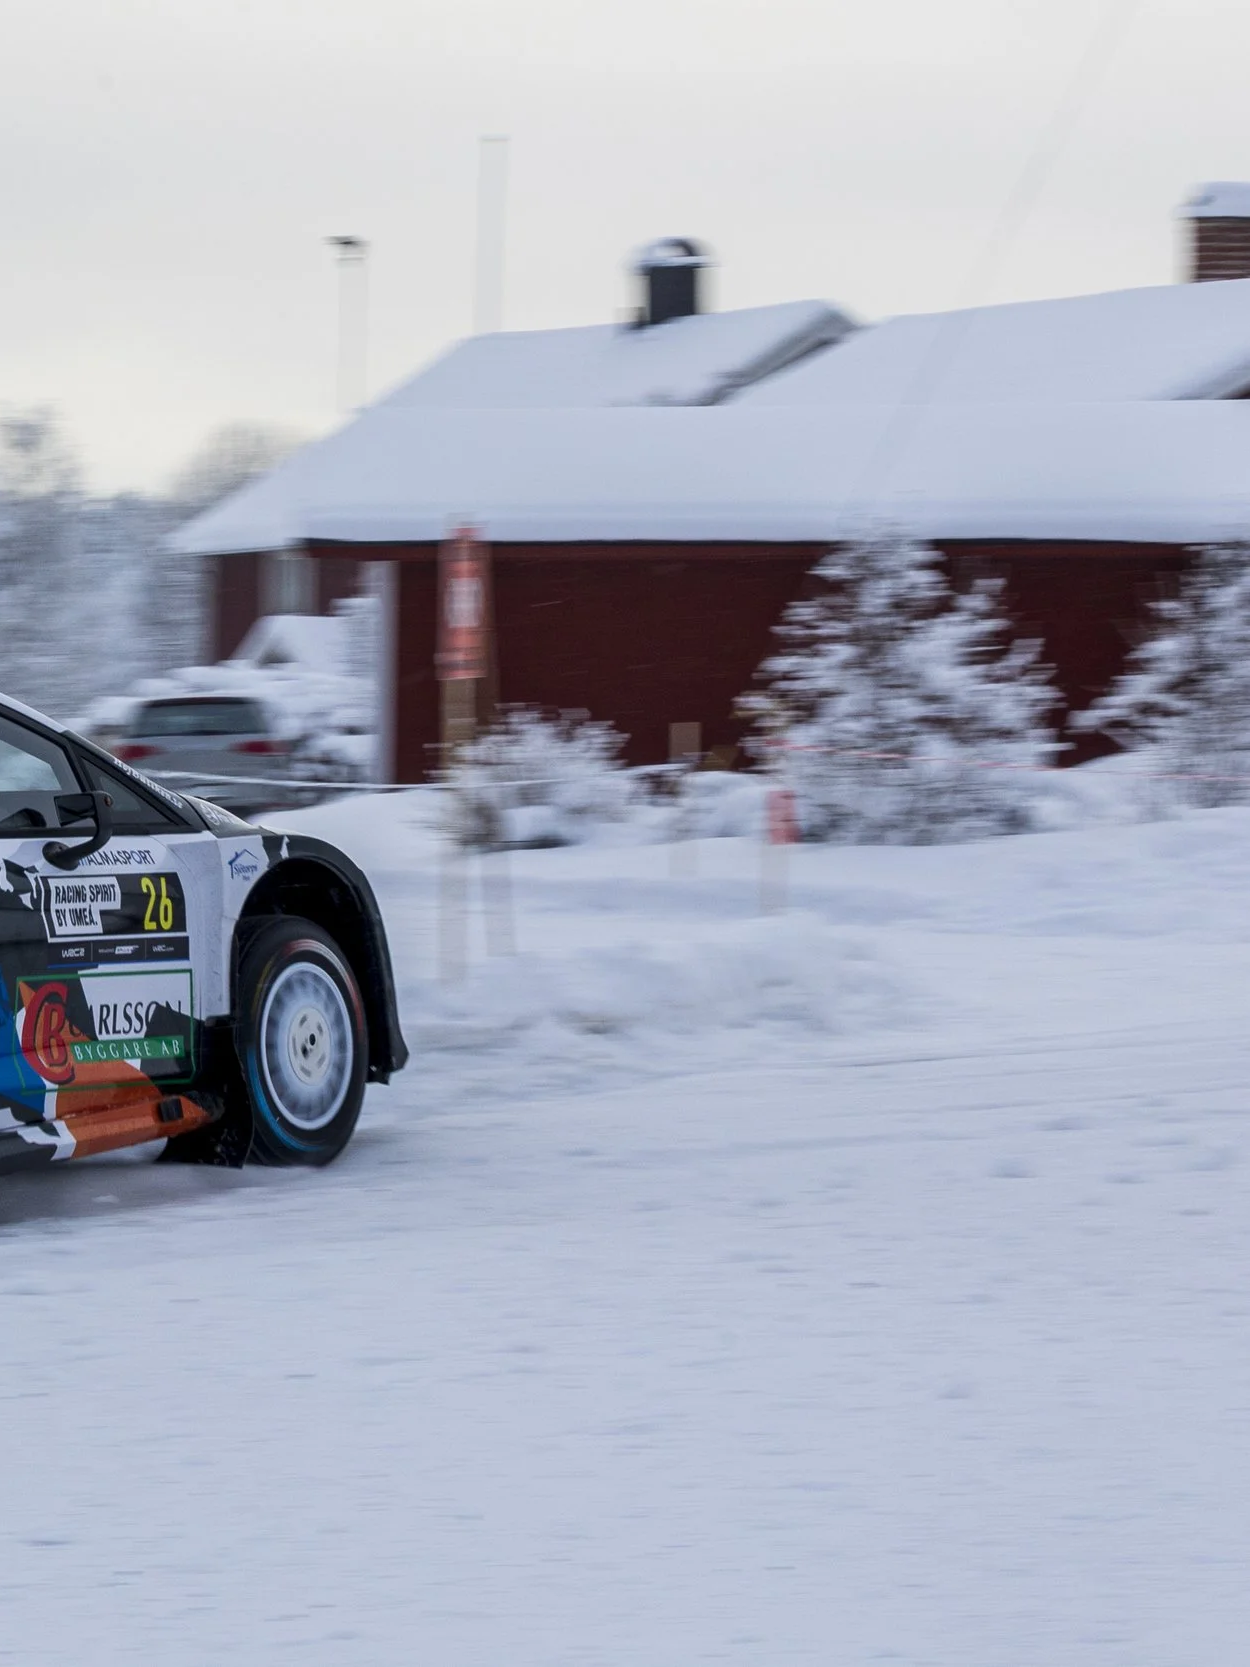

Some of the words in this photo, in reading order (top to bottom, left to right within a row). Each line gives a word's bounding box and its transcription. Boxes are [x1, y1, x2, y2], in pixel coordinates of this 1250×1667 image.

[78, 849, 156, 867] ALMASPORT
[54, 885, 87, 905] RACING
[89, 883, 117, 903] SPIRIT
[140, 876, 173, 930] 26
[55, 908, 68, 928] BY
[73, 1039, 152, 1061] BYGGARE
[161, 1038, 181, 1056] AB
